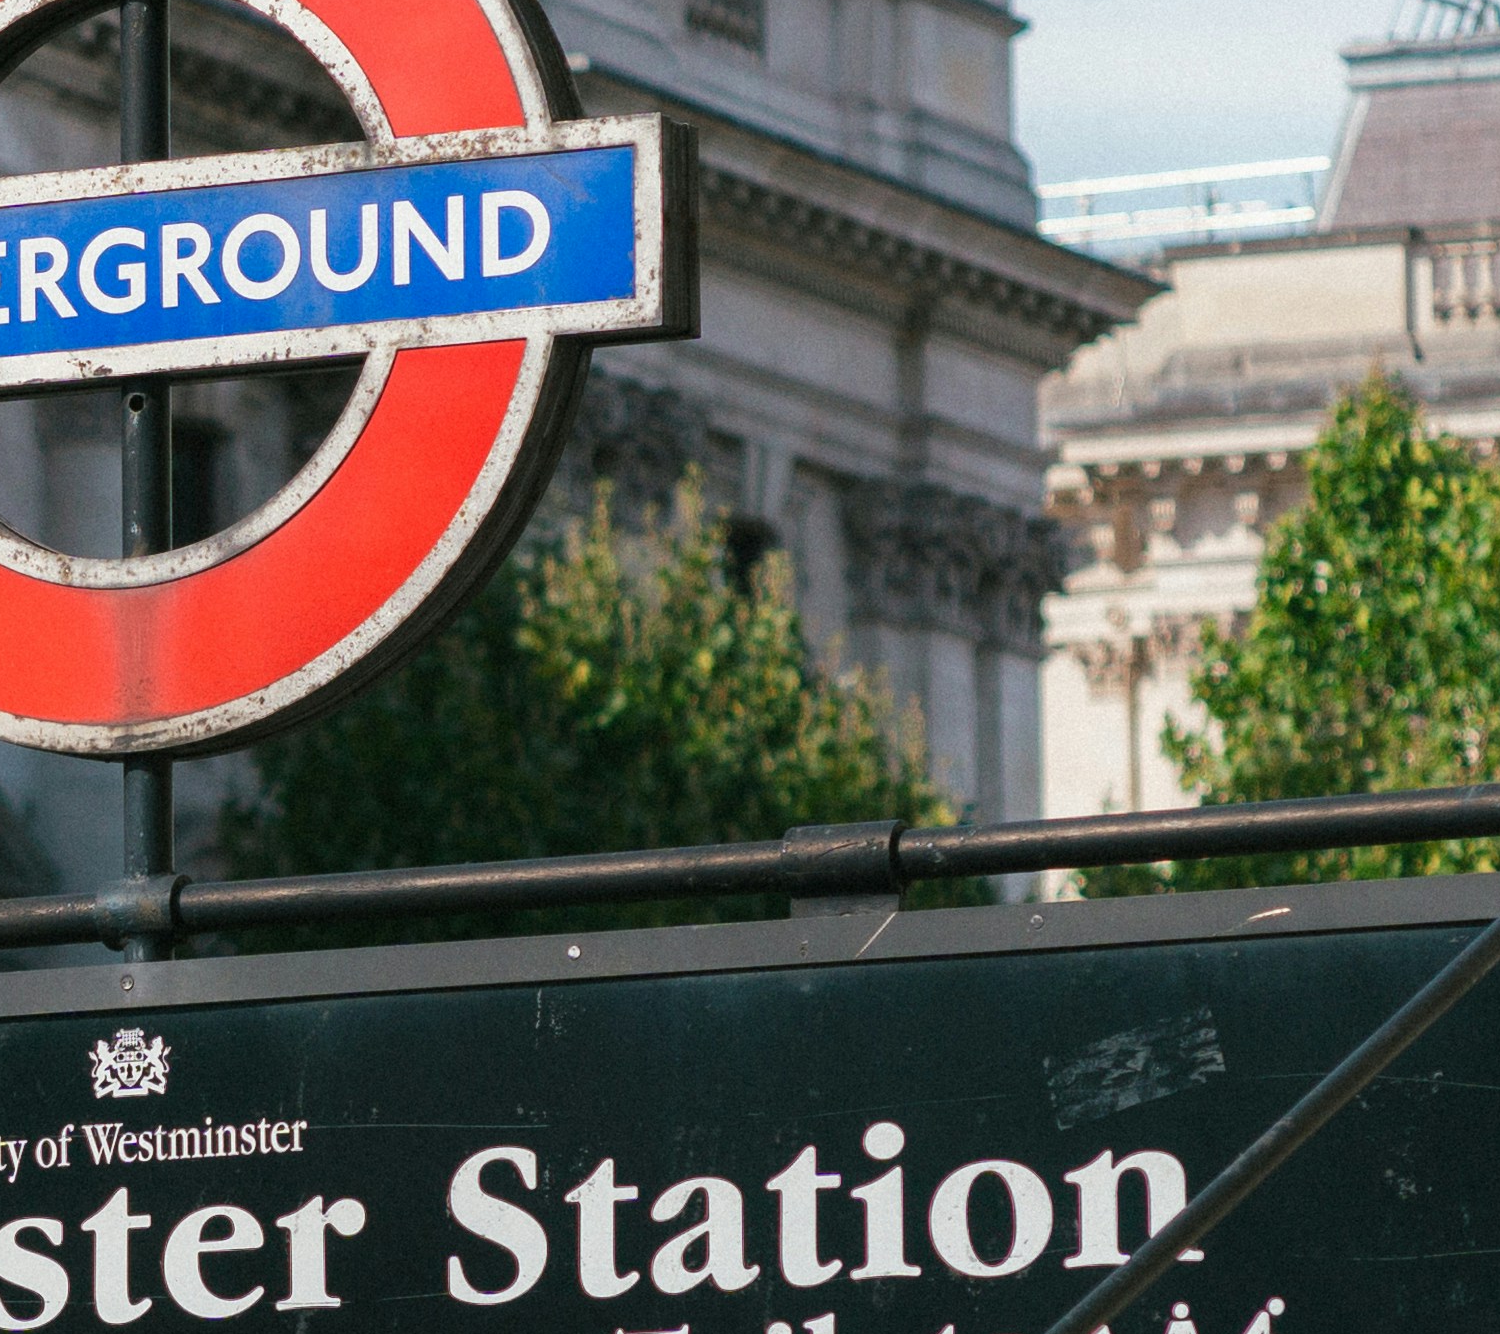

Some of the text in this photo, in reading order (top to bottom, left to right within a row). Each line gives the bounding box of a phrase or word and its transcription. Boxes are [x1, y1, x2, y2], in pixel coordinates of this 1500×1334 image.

[34, 1123, 75, 1169] of
[81, 1116, 308, 1166] Westminster
[447, 1121, 1206, 1307] Station
